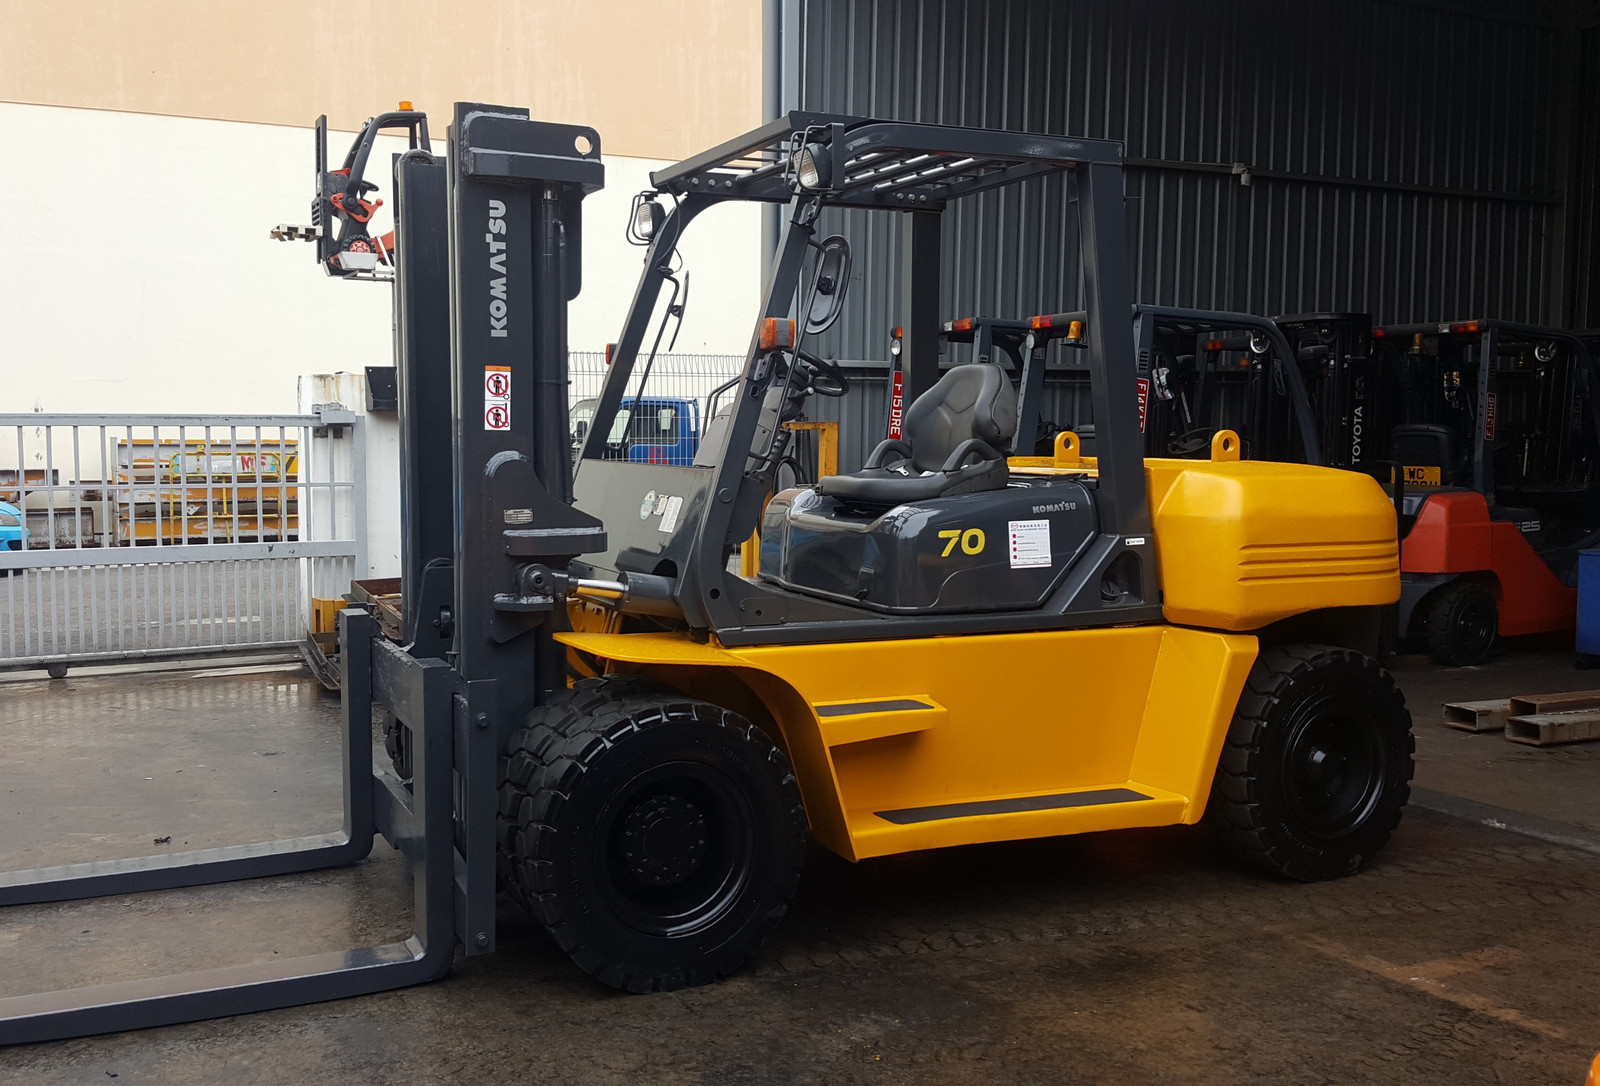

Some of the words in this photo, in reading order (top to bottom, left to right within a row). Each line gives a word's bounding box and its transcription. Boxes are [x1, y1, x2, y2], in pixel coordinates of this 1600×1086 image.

[486, 199, 508, 338] KOMATSU
[1351, 405, 1363, 465] TOYOTA
[1032, 501, 1077, 514] KOMATSU
[937, 527, 986, 558] 70
